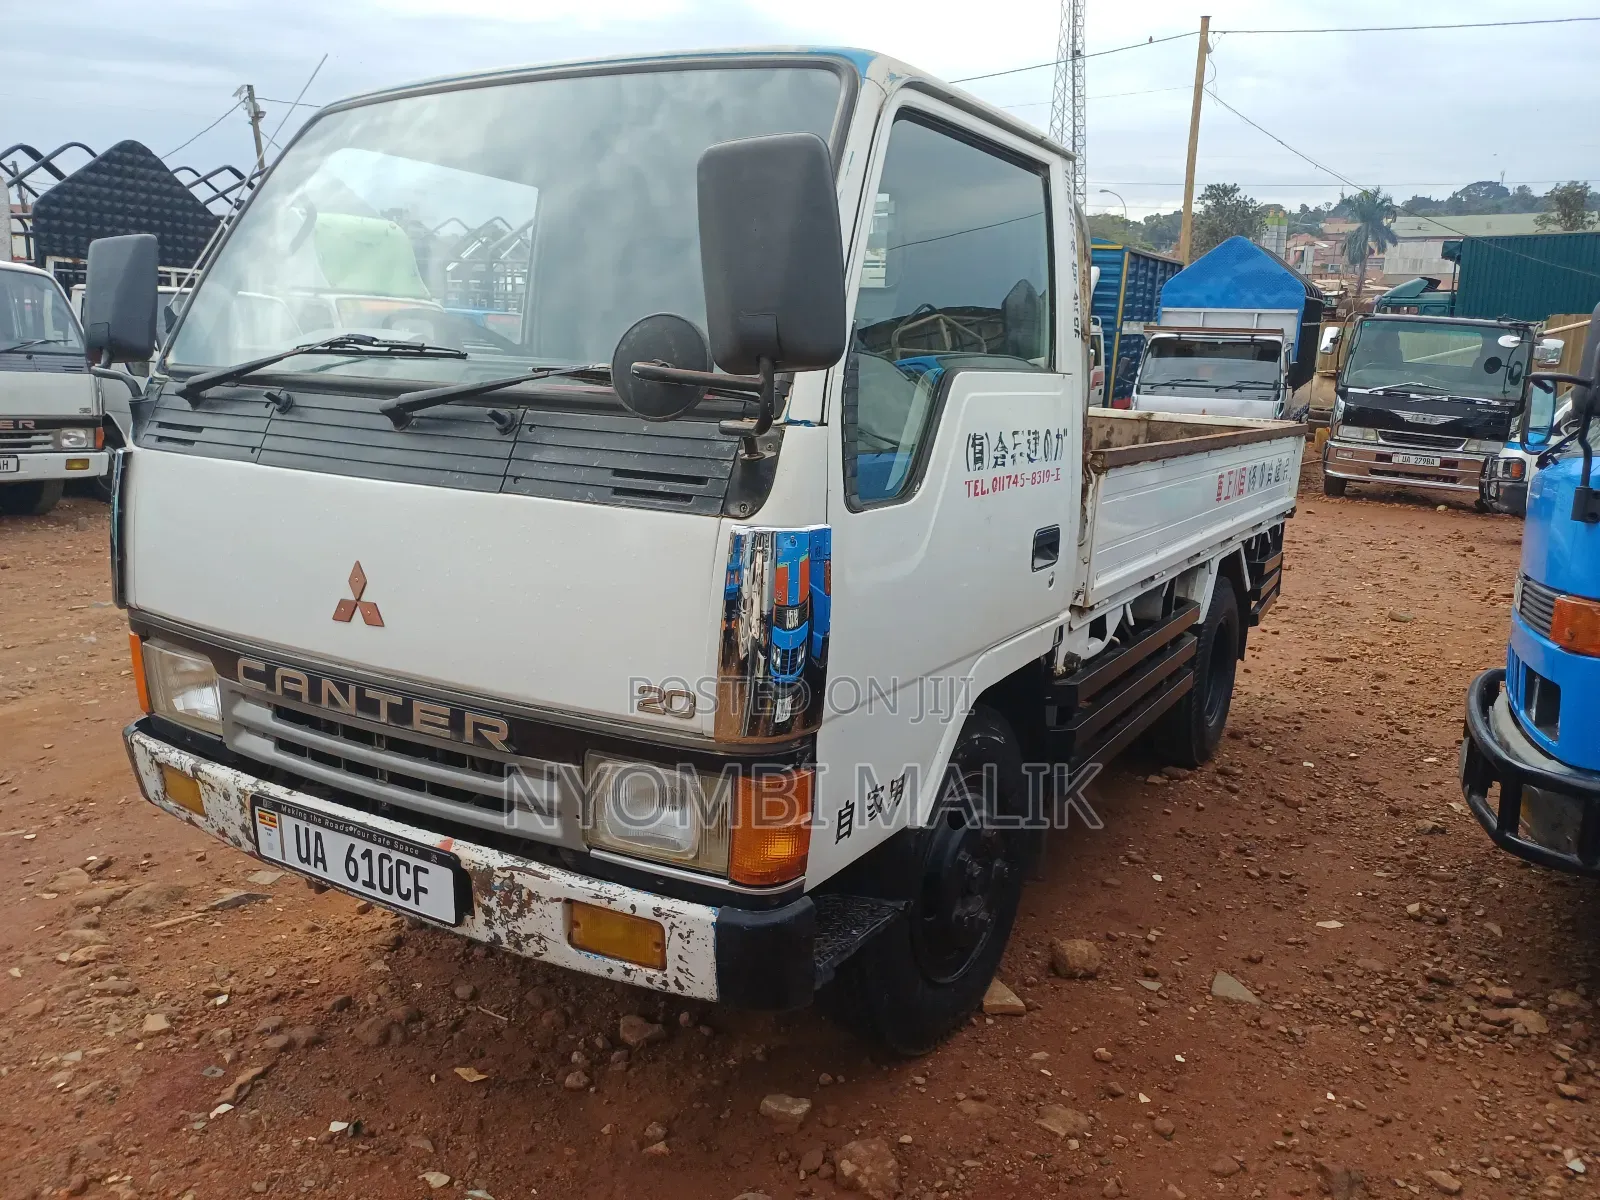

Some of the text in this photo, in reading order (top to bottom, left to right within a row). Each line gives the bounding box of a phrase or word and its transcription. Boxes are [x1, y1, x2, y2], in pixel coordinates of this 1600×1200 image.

[1401, 453, 1411, 463] UA
[237, 657, 514, 754] CANTER
[637, 685, 696, 719] 20
[280, 804, 419, 855] Making the Roads Your Safe Space
[294, 824, 429, 906] UA 610CF
